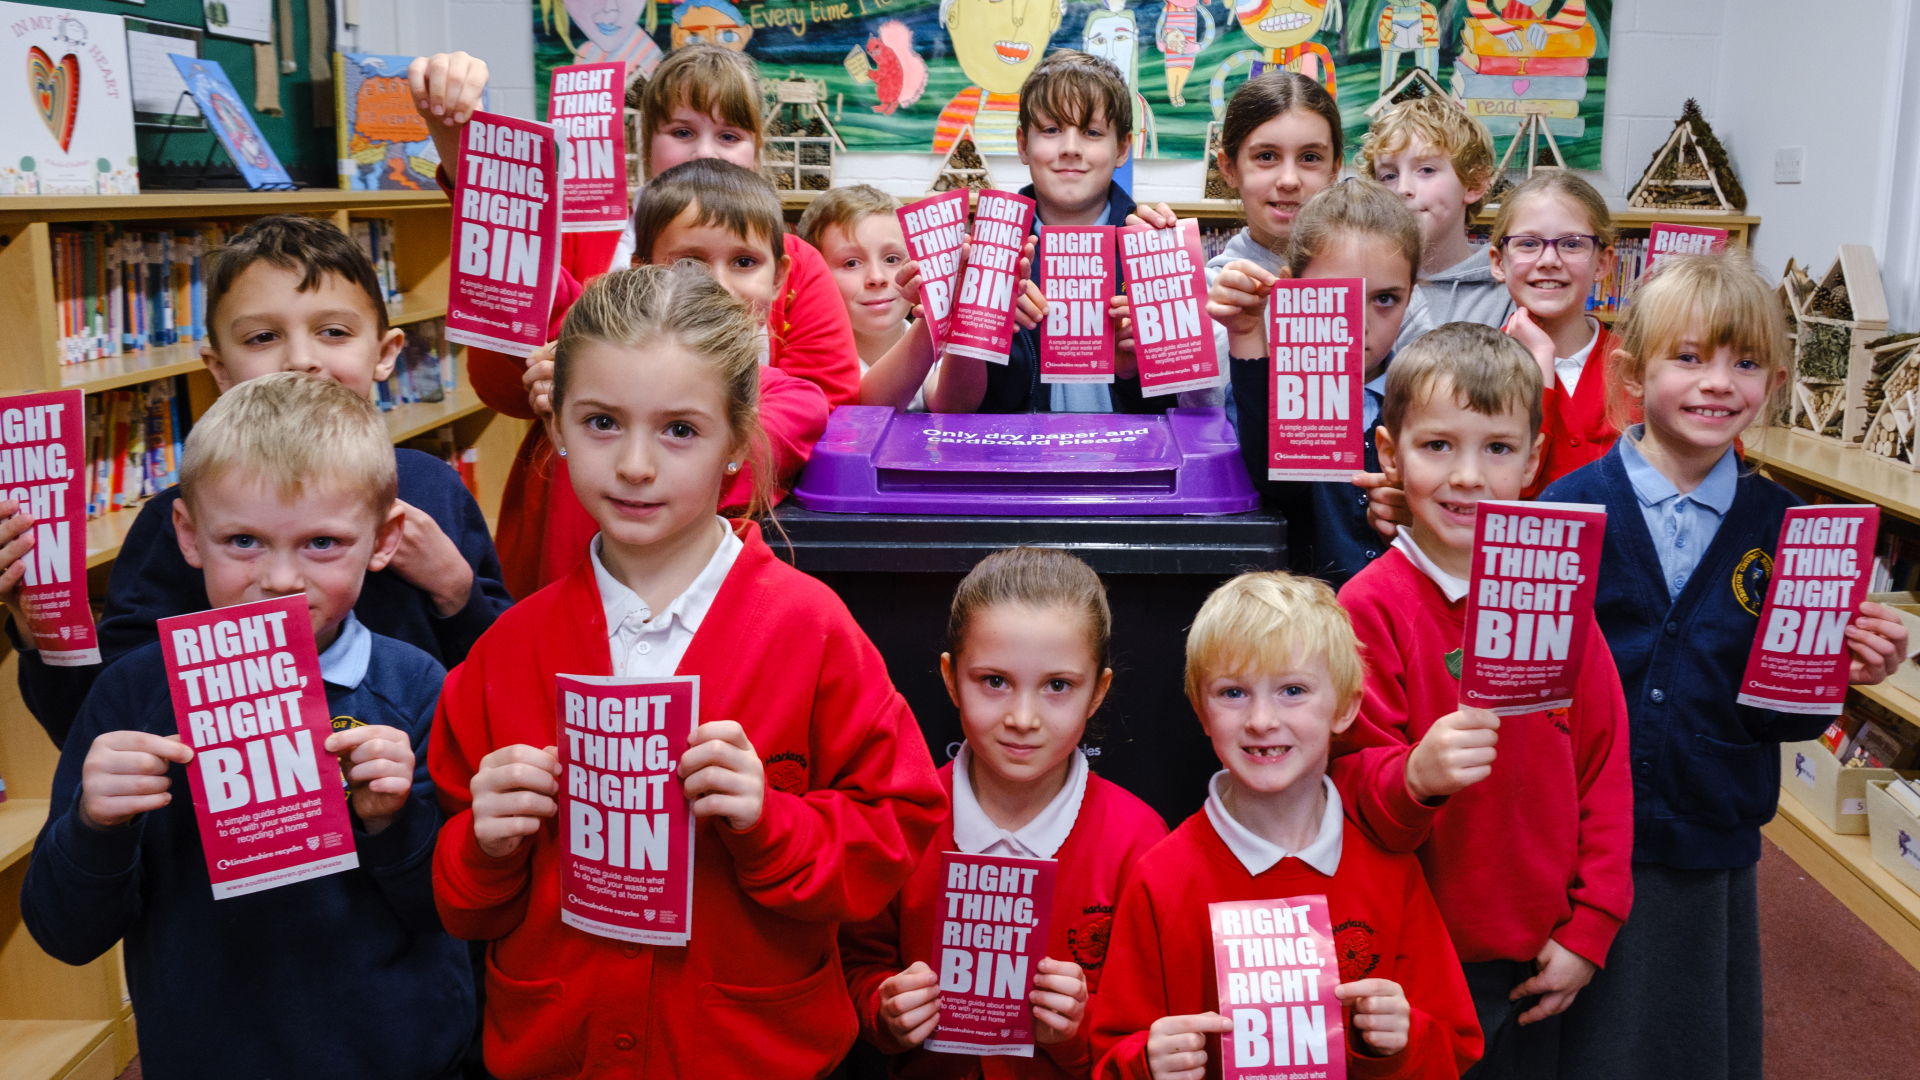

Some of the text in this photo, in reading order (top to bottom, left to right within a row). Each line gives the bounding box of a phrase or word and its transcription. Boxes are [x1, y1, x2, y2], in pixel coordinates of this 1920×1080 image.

[11, 16, 53, 38] IN MY
[751, 4, 806, 37] Every
[811, 1, 852, 23] time
[88, 45, 120, 99] HEART
[555, 69, 615, 93] RIGHT
[1518, 57, 1529, 75] I
[553, 92, 616, 115] THING,
[468, 120, 544, 165] RIGHT
[466, 154, 549, 202] THING,
[462, 188, 543, 232] RIGHT
[904, 197, 962, 235] RIGHT
[977, 196, 1028, 225] RIGHT
[975, 220, 1022, 250] THING,
[1046, 233, 1104, 254] RIGHT
[1123, 226, 1185, 256] RIGHT
[1655, 230, 1716, 255] RIGHT
[459, 221, 542, 287] BIN
[968, 244, 1019, 272] RIGHT
[1045, 256, 1107, 278] THING,
[1127, 250, 1196, 280] THING,
[959, 267, 1015, 313] BIN
[1046, 279, 1104, 299] RIGHT
[1131, 274, 1193, 305] RIGHT
[1276, 287, 1348, 314] RIGHT
[1047, 301, 1104, 337] BIN
[1135, 298, 1201, 345] BIN
[1275, 316, 1353, 345] THING,
[1276, 346, 1349, 372] RIGHT
[1277, 375, 1350, 420] BIN
[0, 403, 64, 444] GHT
[922, 428, 1149, 441] Only dry paper and
[928, 436, 1137, 446] cardboard please
[0, 443, 74, 484] HING,
[1484, 513, 1586, 548] RIGHT
[1785, 517, 1864, 545] RIGHT
[1482, 546, 1585, 584] THING,
[1782, 548, 1860, 579] THING,
[1478, 579, 1578, 612] RIGHT
[1773, 580, 1855, 608] RIGHT
[172, 611, 288, 666] RIGHT
[1475, 610, 1574, 661] BIN
[1762, 608, 1852, 655] BIN
[179, 652, 308, 706] THING,
[188, 690, 302, 748] RIGHT
[565, 690, 671, 733] RIGHT
[565, 727, 676, 772] THING,
[198, 730, 322, 814] BIN
[568, 764, 669, 810] RIGHT
[216, 798, 322, 828] A simple guide about what
[219, 808, 322, 837] to do with your waste and
[237, 822, 308, 844] recycling at home
[570, 799, 669, 871] BIN
[230, 845, 304, 866] Lincolnshire recycles
[574, 870, 581, 878] to
[582, 873, 590, 881] do
[592, 877, 606, 885] with
[607, 881, 623, 889] your
[625, 884, 647, 892] waste
[579, 864, 601, 875] simple
[602, 871, 622, 880] guide
[623, 875, 645, 883] about
[947, 863, 1038, 894] RIGHT
[578, 899, 639, 917] Lincolnshire recycles
[586, 884, 616, 898] recycling
[627, 892, 648, 901] home
[945, 892, 1038, 927] THING,
[1221, 905, 1310, 935] RIGHT
[942, 921, 1032, 953] RIGHT
[1223, 937, 1325, 968] THING,
[940, 948, 1029, 1000] BIN
[1228, 969, 1321, 1005] RIGHT
[947, 997, 967, 1005] simple
[968, 1000, 985, 1008] guide
[952, 1012, 979, 1021] recycling
[942, 1026, 975, 1034] Lincolnshire
[1233, 1005, 1328, 1068] BIN
